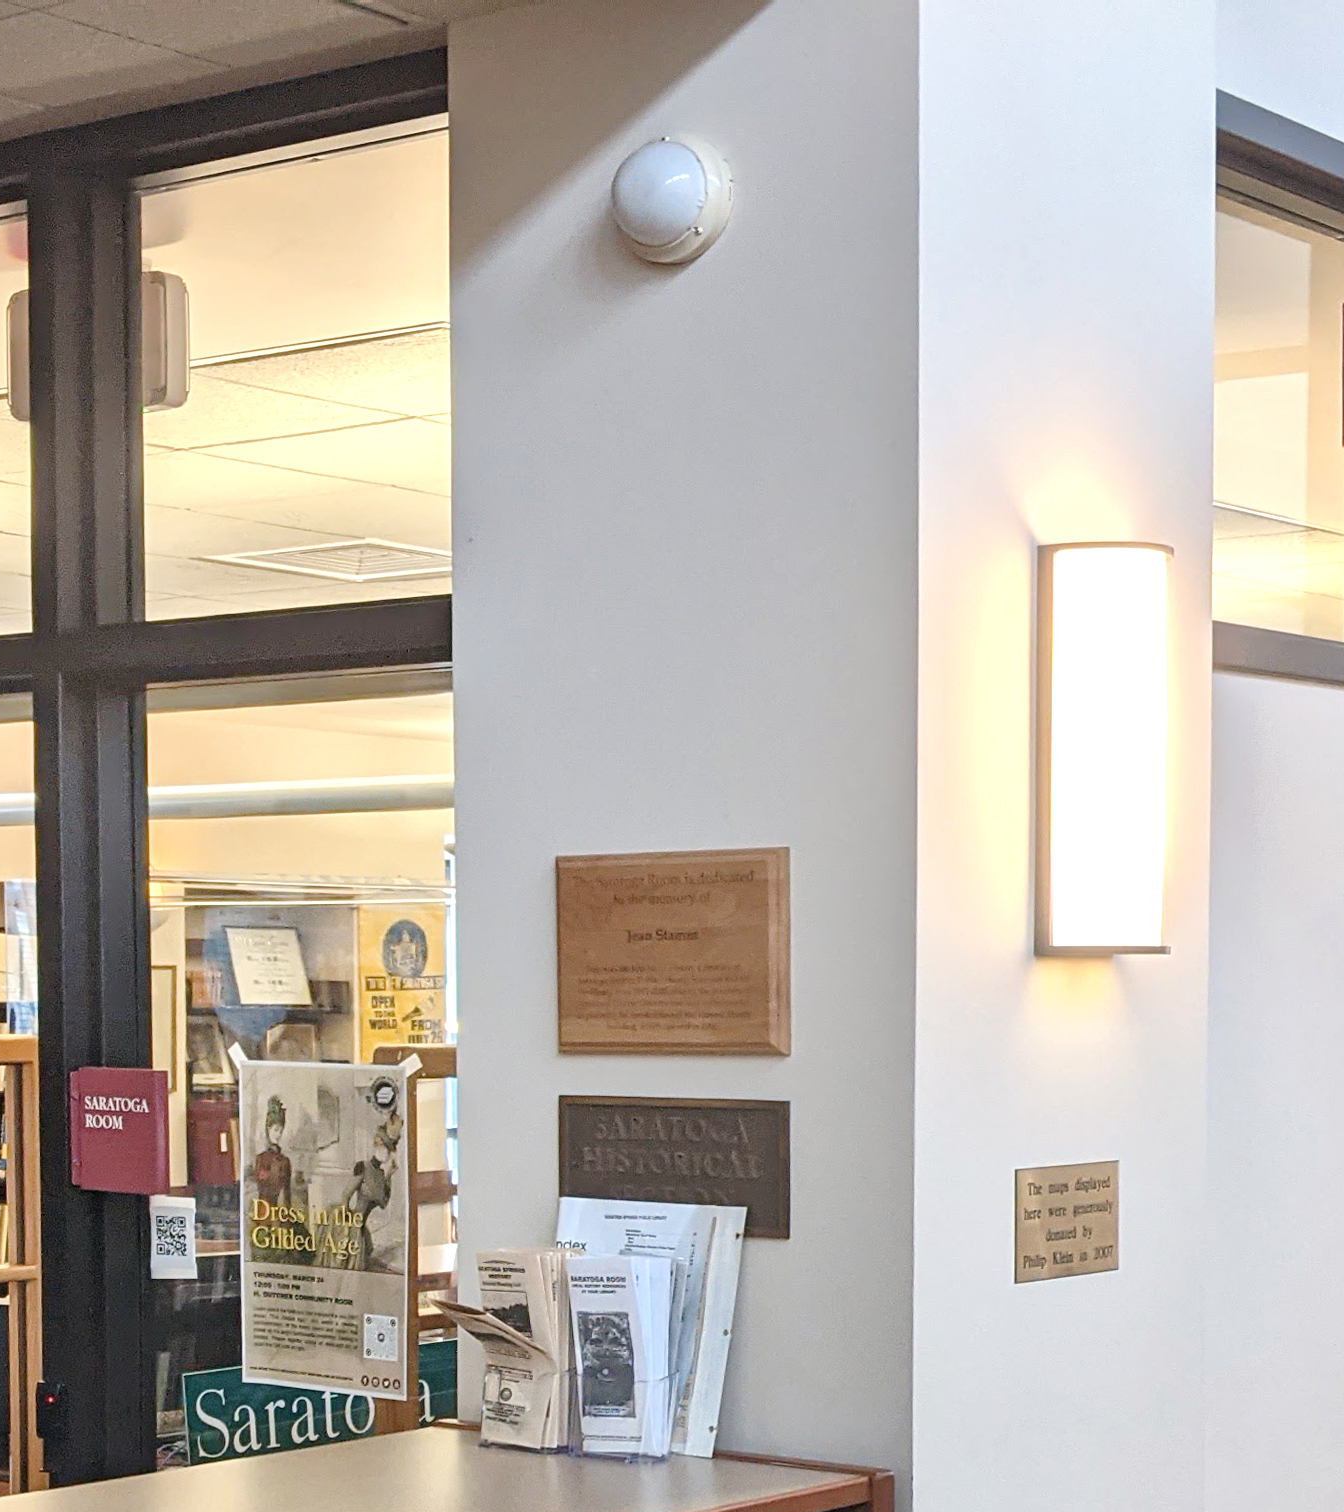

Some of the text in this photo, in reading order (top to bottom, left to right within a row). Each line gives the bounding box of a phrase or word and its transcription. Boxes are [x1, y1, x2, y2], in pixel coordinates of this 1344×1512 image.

[626, 929, 653, 944] Jean
[84, 1095, 150, 1114] SARATOGA
[85, 1114, 124, 1131] ROOM
[595, 1113, 750, 1145] SARATOGA
[581, 1146, 762, 1180] HISTORICAL
[1027, 1182, 1043, 1196] The
[1075, 1176, 1111, 1194] displayed
[252, 1198, 364, 1228] Dress in the
[1024, 1207, 1042, 1221] here
[1048, 1206, 1067, 1218] were
[252, 1226, 361, 1259] Gilded Age
[1045, 1225, 1093, 1242] donated by
[556, 1240, 587, 1252] ndex
[1093, 1244, 1114, 1261] 2007
[570, 1275, 626, 1284] SARATOGA ROOM
[196, 1379, 435, 1459] Saratoa
